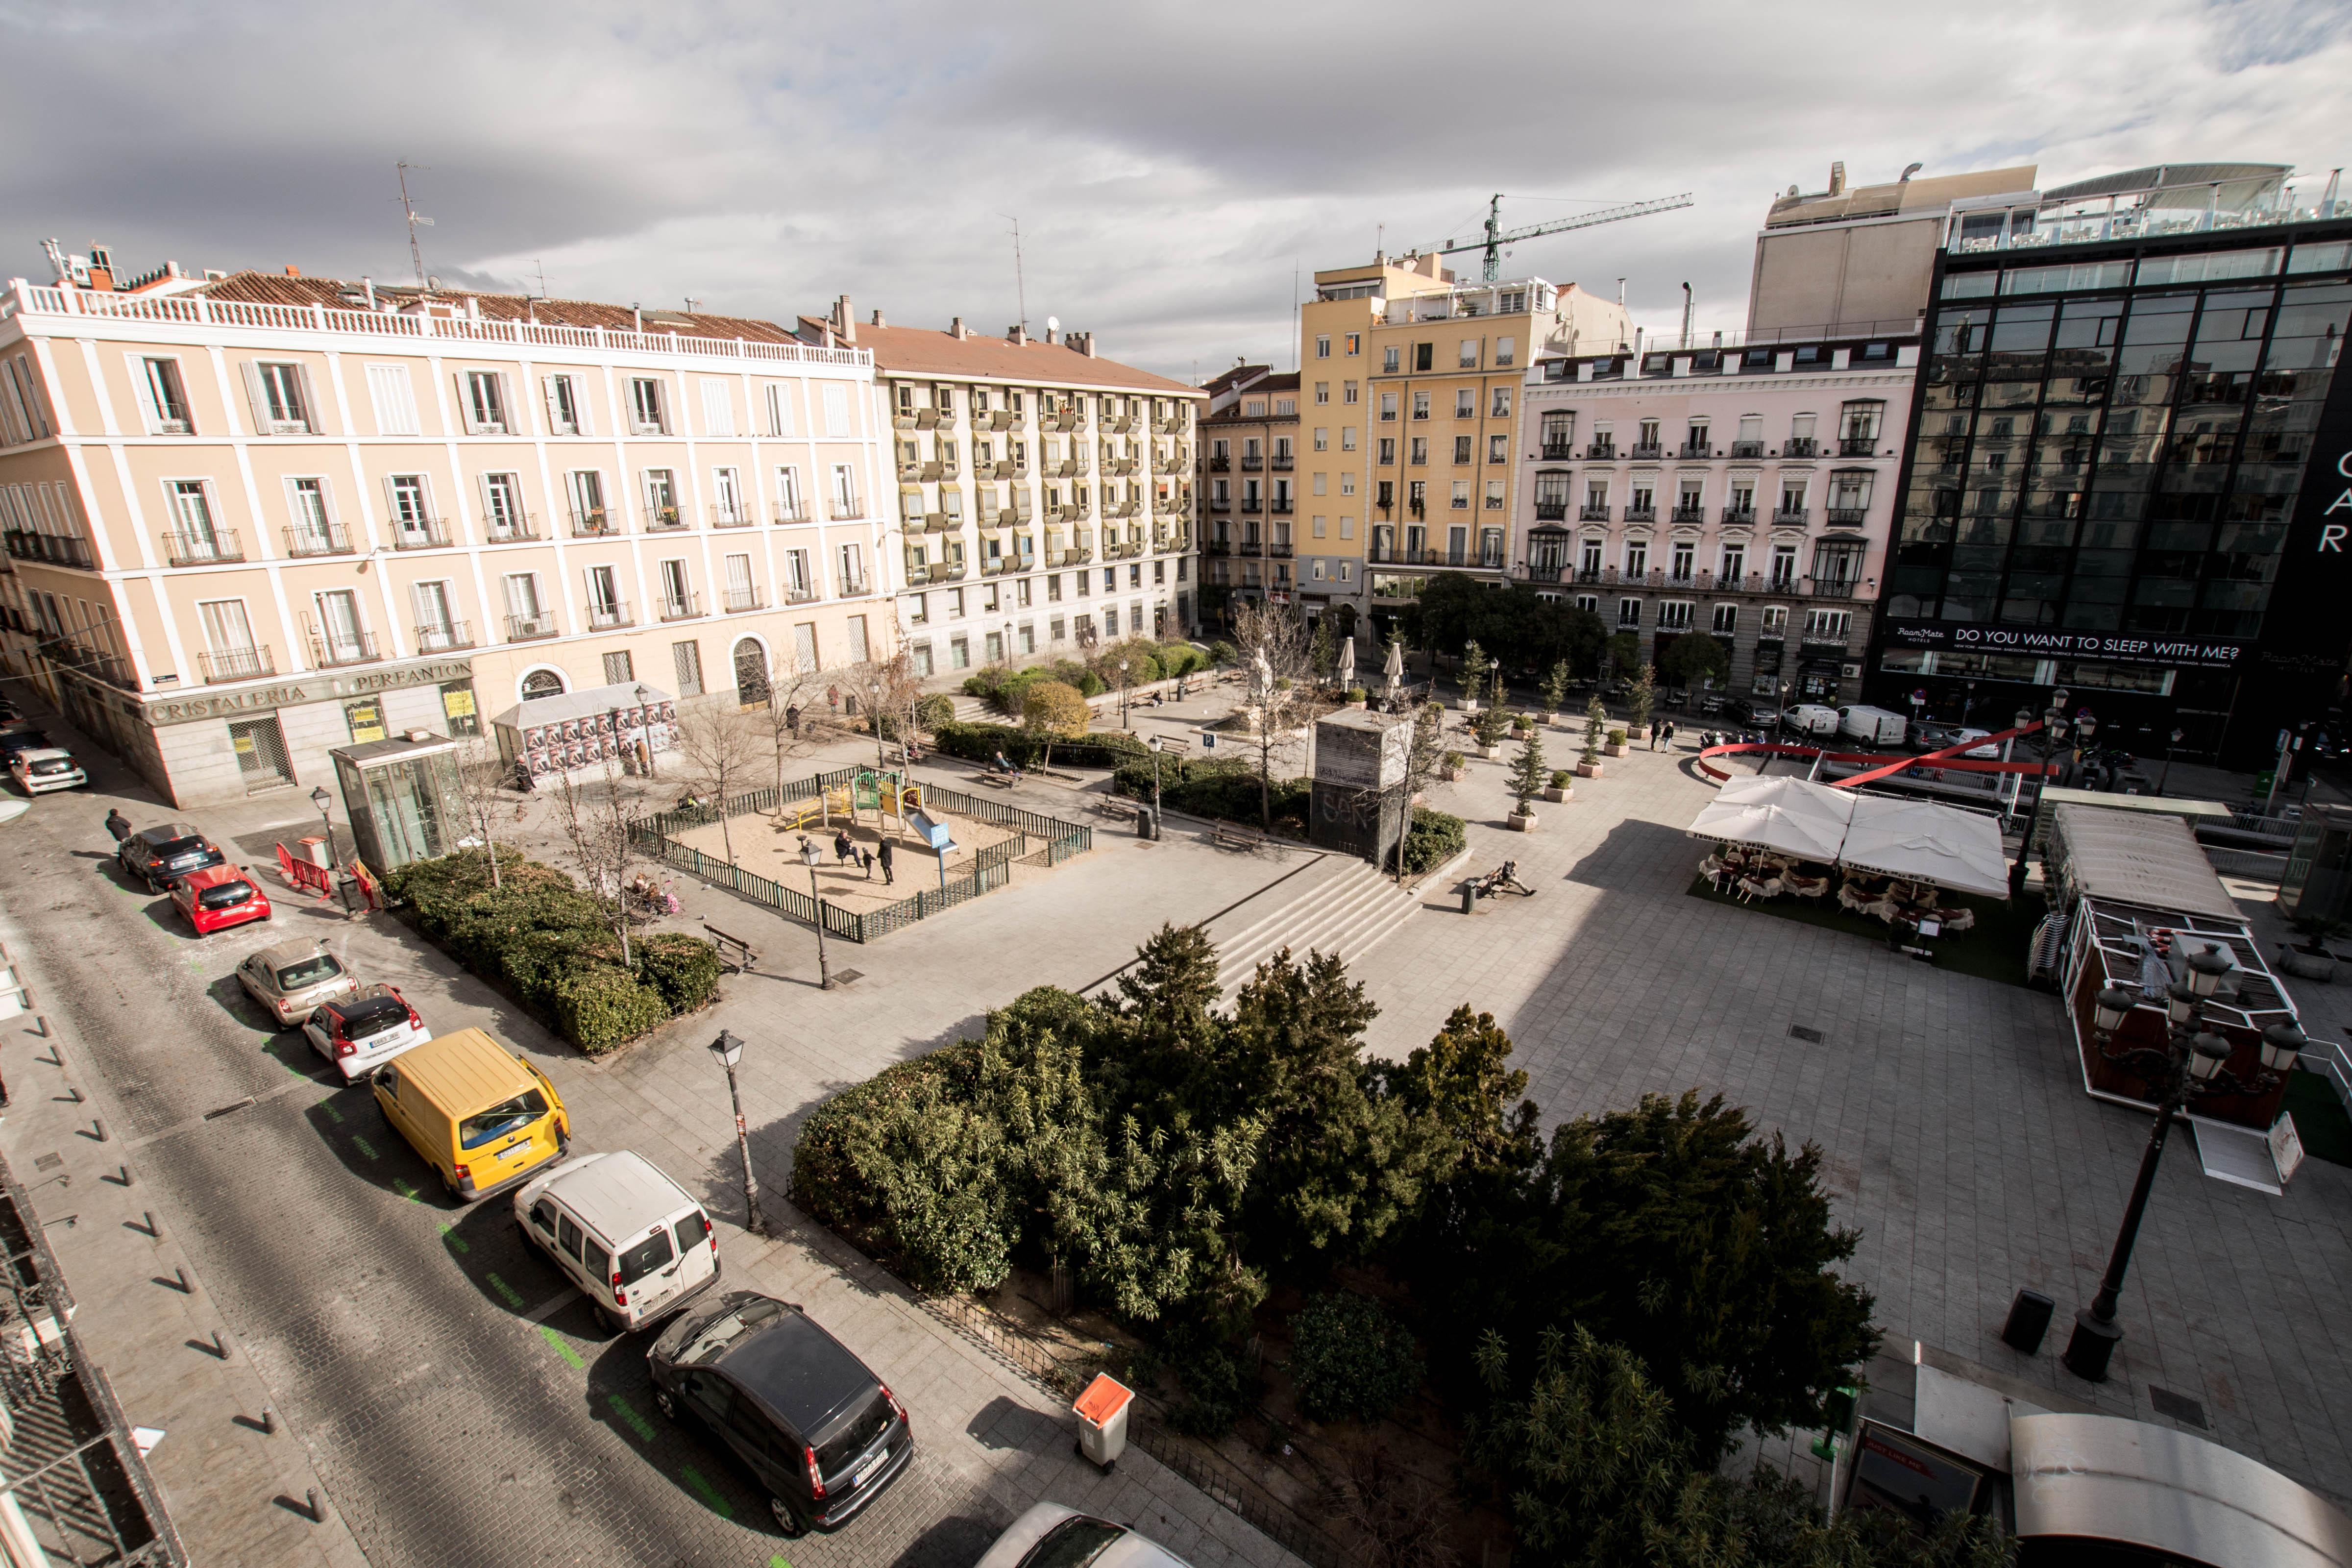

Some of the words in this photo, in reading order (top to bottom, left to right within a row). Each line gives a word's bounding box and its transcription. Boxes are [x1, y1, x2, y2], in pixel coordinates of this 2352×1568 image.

[1956, 629, 1980, 641] DO
[1985, 631, 2018, 644] YOU
[2024, 634, 2073, 647] WANT
[2077, 637, 2099, 649] TO
[2104, 639, 2149, 653] SLEEP
[2154, 642, 2199, 657] WITH
[2202, 645, 2241, 660] ME?
[150, 686, 306, 720] CRISTALERIA
[1205, 735, 1211, 745] P
[644, 1298, 659, 1312] 0927
[661, 1292, 672, 1301] FHY
[1889, 1451, 1907, 1463] LIKE
